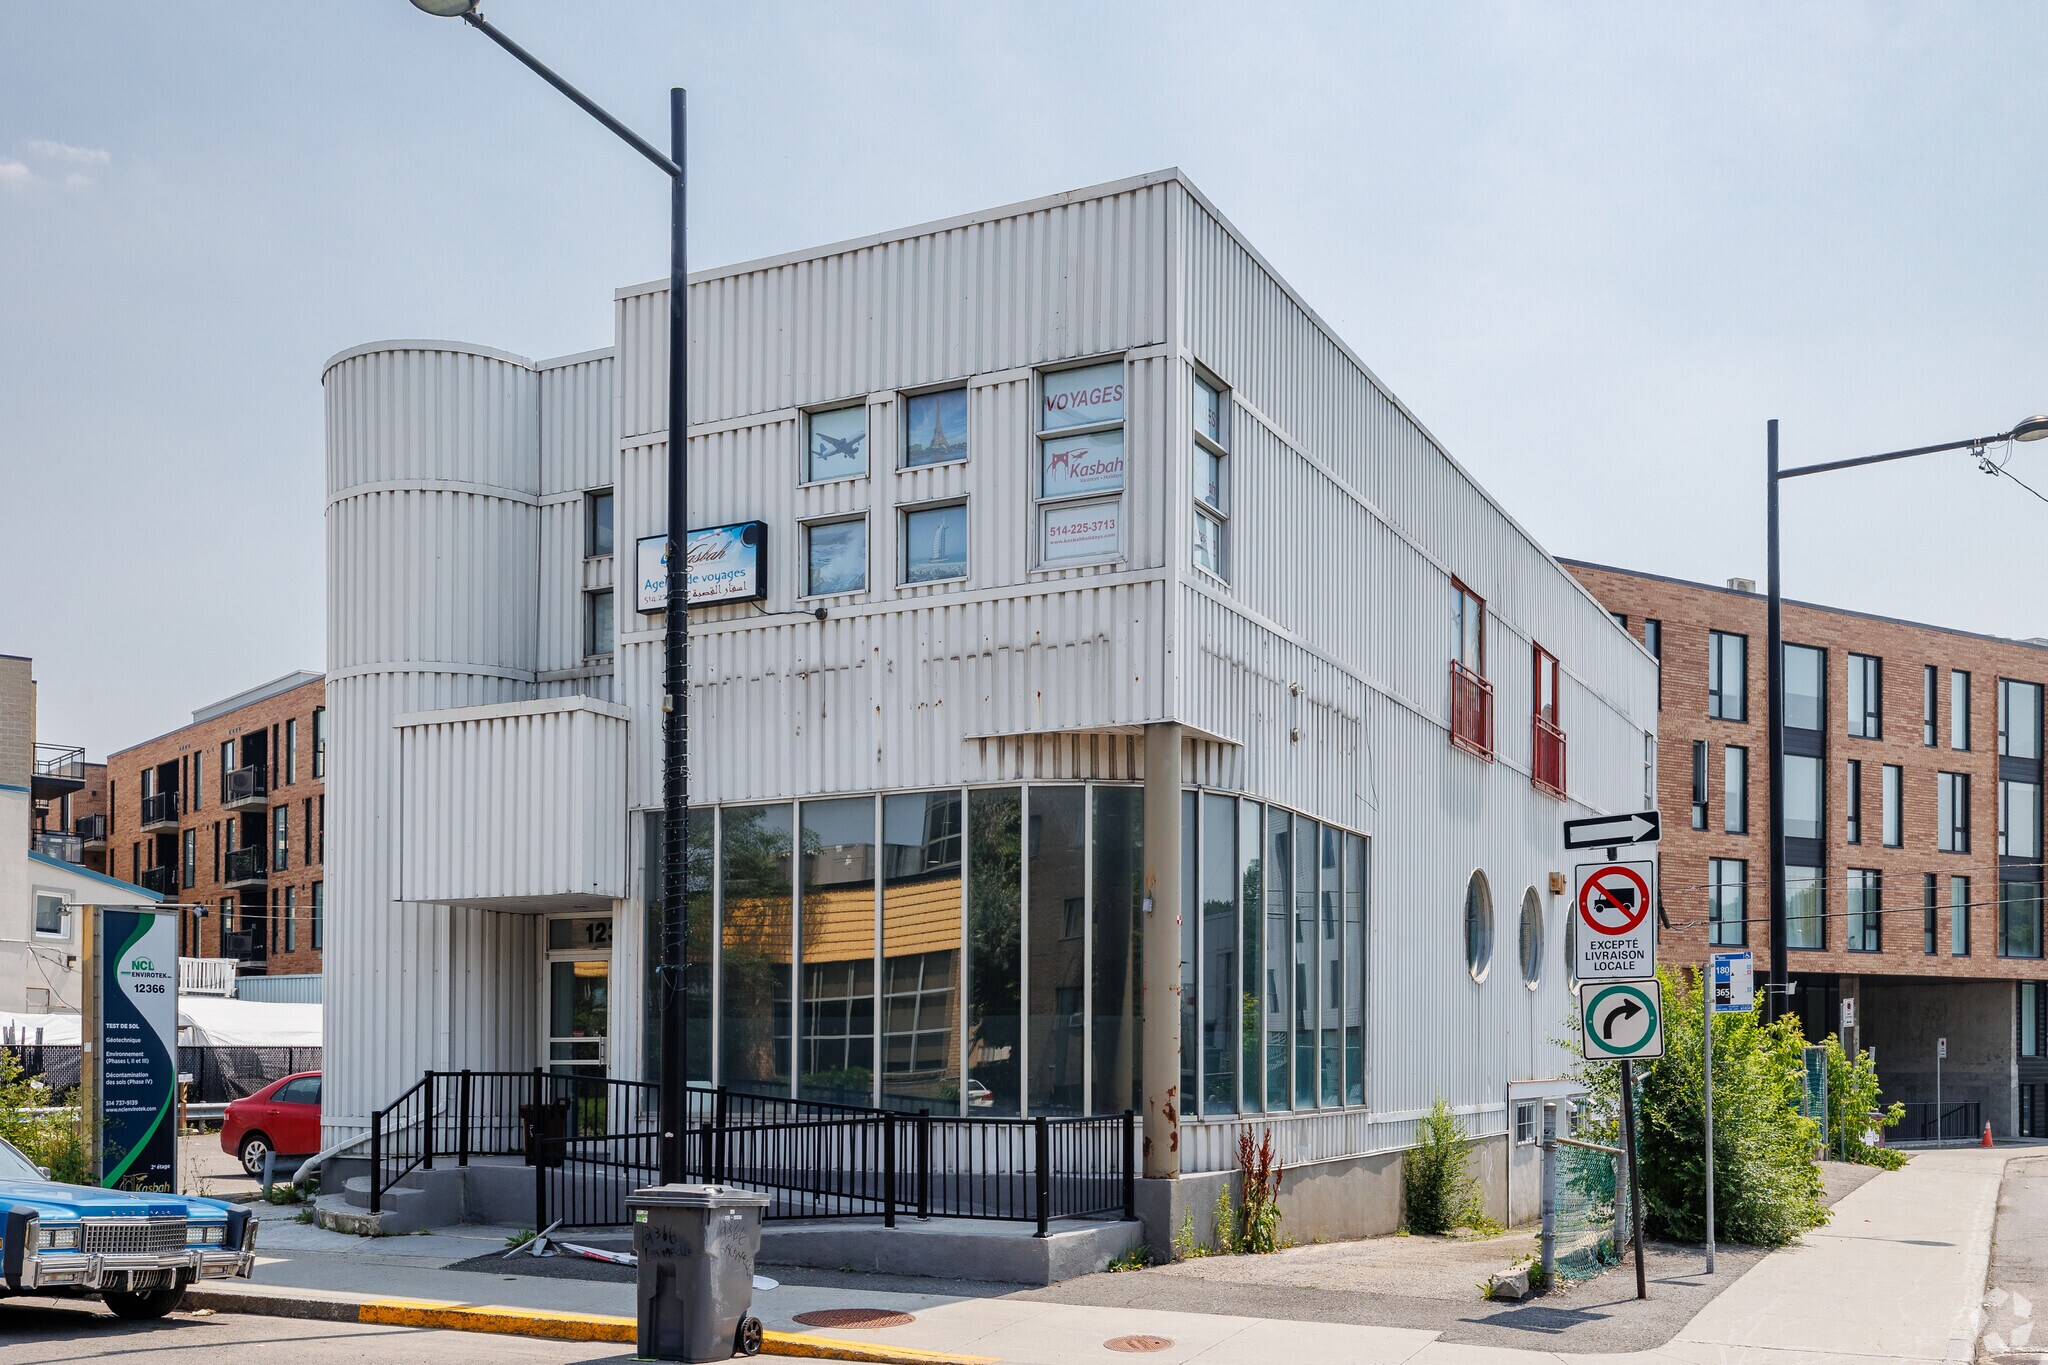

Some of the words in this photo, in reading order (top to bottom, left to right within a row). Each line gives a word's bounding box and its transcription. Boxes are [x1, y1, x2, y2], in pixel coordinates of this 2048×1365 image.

[1046, 384, 1124, 412] VOYAGES
[1070, 457, 1123, 478] Kasbah
[1050, 519, 1115, 537] 514-225-3713
[1050, 533, 1115, 545] www.kasbahholidays.com
[701, 568, 746, 583] voyages
[1590, 937, 1639, 950] EXCEPTÉ
[1585, 950, 1645, 961] LIVRAISON
[132, 960, 155, 971] NCL
[1594, 961, 1635, 971] LOCALE
[1716, 966, 1730, 975] 180
[134, 984, 165, 994] 12366
[1716, 988, 1730, 997] 365
[136, 1181, 171, 1193] Kasbah
